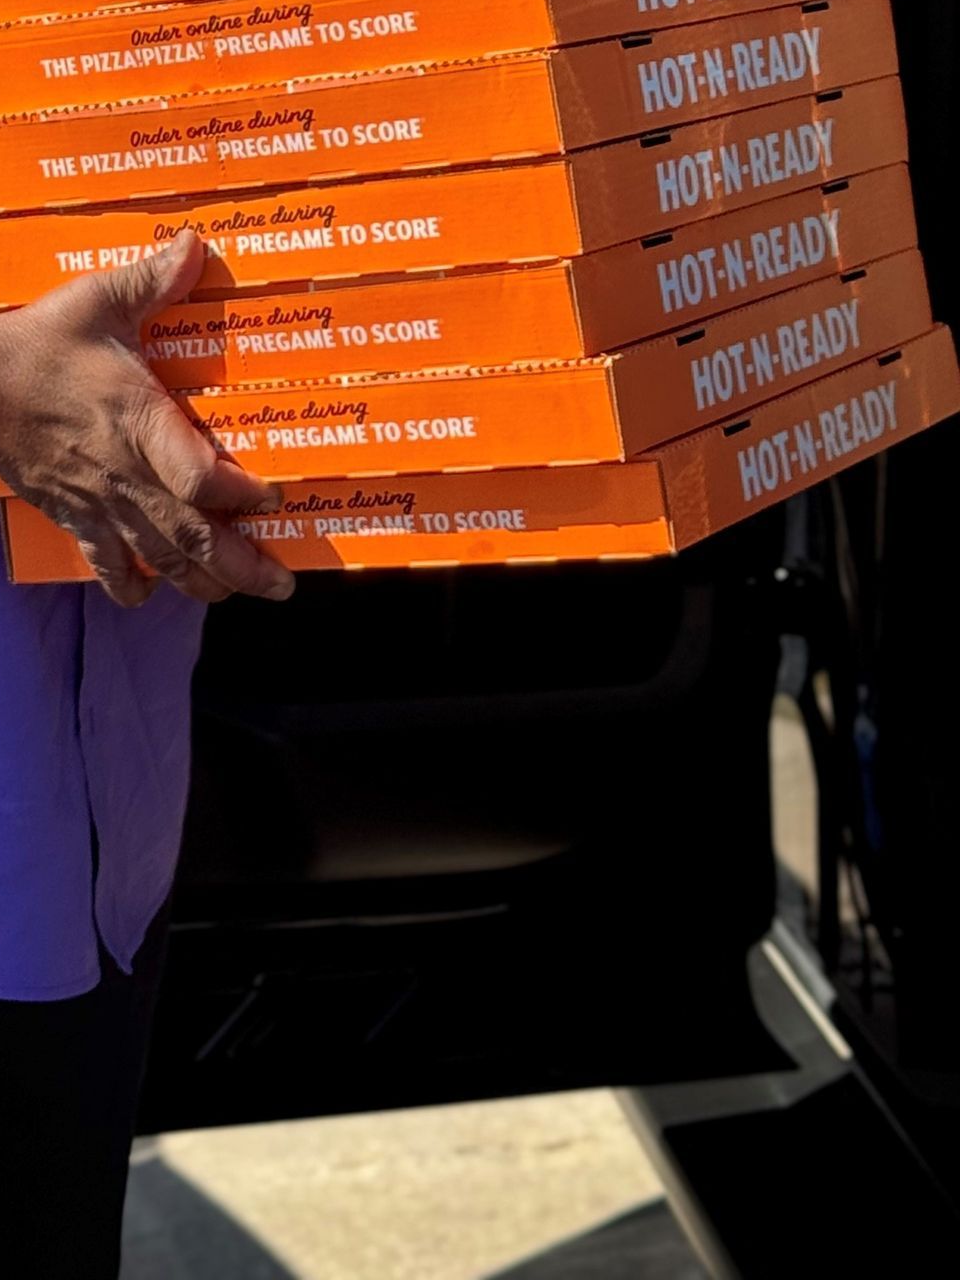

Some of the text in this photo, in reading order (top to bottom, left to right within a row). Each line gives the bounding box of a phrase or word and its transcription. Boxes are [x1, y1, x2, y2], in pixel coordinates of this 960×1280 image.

[42, 58, 77, 77] THE
[215, 27, 313, 55] PREGAME
[316, 22, 344, 42] TO
[349, 12, 416, 39] SCORE
[131, 4, 313, 47] Order online during
[638, 27, 820, 112] HOT-N-READY
[40, 158, 76, 177] THE
[218, 131, 315, 159] PREGAME
[320, 128, 348, 147] TO
[353, 118, 421, 144] SCORE
[131, 109, 315, 147] Order online during
[656, 119, 832, 212] HOT-N-READY
[211, 212, 266, 232] online
[270, 205, 337, 228] during
[56, 250, 94, 271] THE
[236, 227, 334, 255] PREGAME
[338, 224, 367, 245] TO
[371, 217, 439, 242] SCORE
[658, 210, 839, 312] HOT-N-READY
[144, 320, 440, 360] A!PIZZA! PREGAME TO SCORE
[151, 307, 334, 339] Order online during
[692, 299, 859, 409] HOT-N-READY
[193, 401, 369, 429] der online during
[267, 424, 367, 448] PREGAME
[371, 422, 401, 441] TO
[405, 417, 475, 440] SCORE
[738, 382, 896, 500] HOT-N-READY
[284, 494, 343, 514] online
[347, 490, 416, 515] during
[315, 515, 414, 537] PREGAME
[420, 514, 449, 531] TO
[454, 510, 525, 531] SCORE
